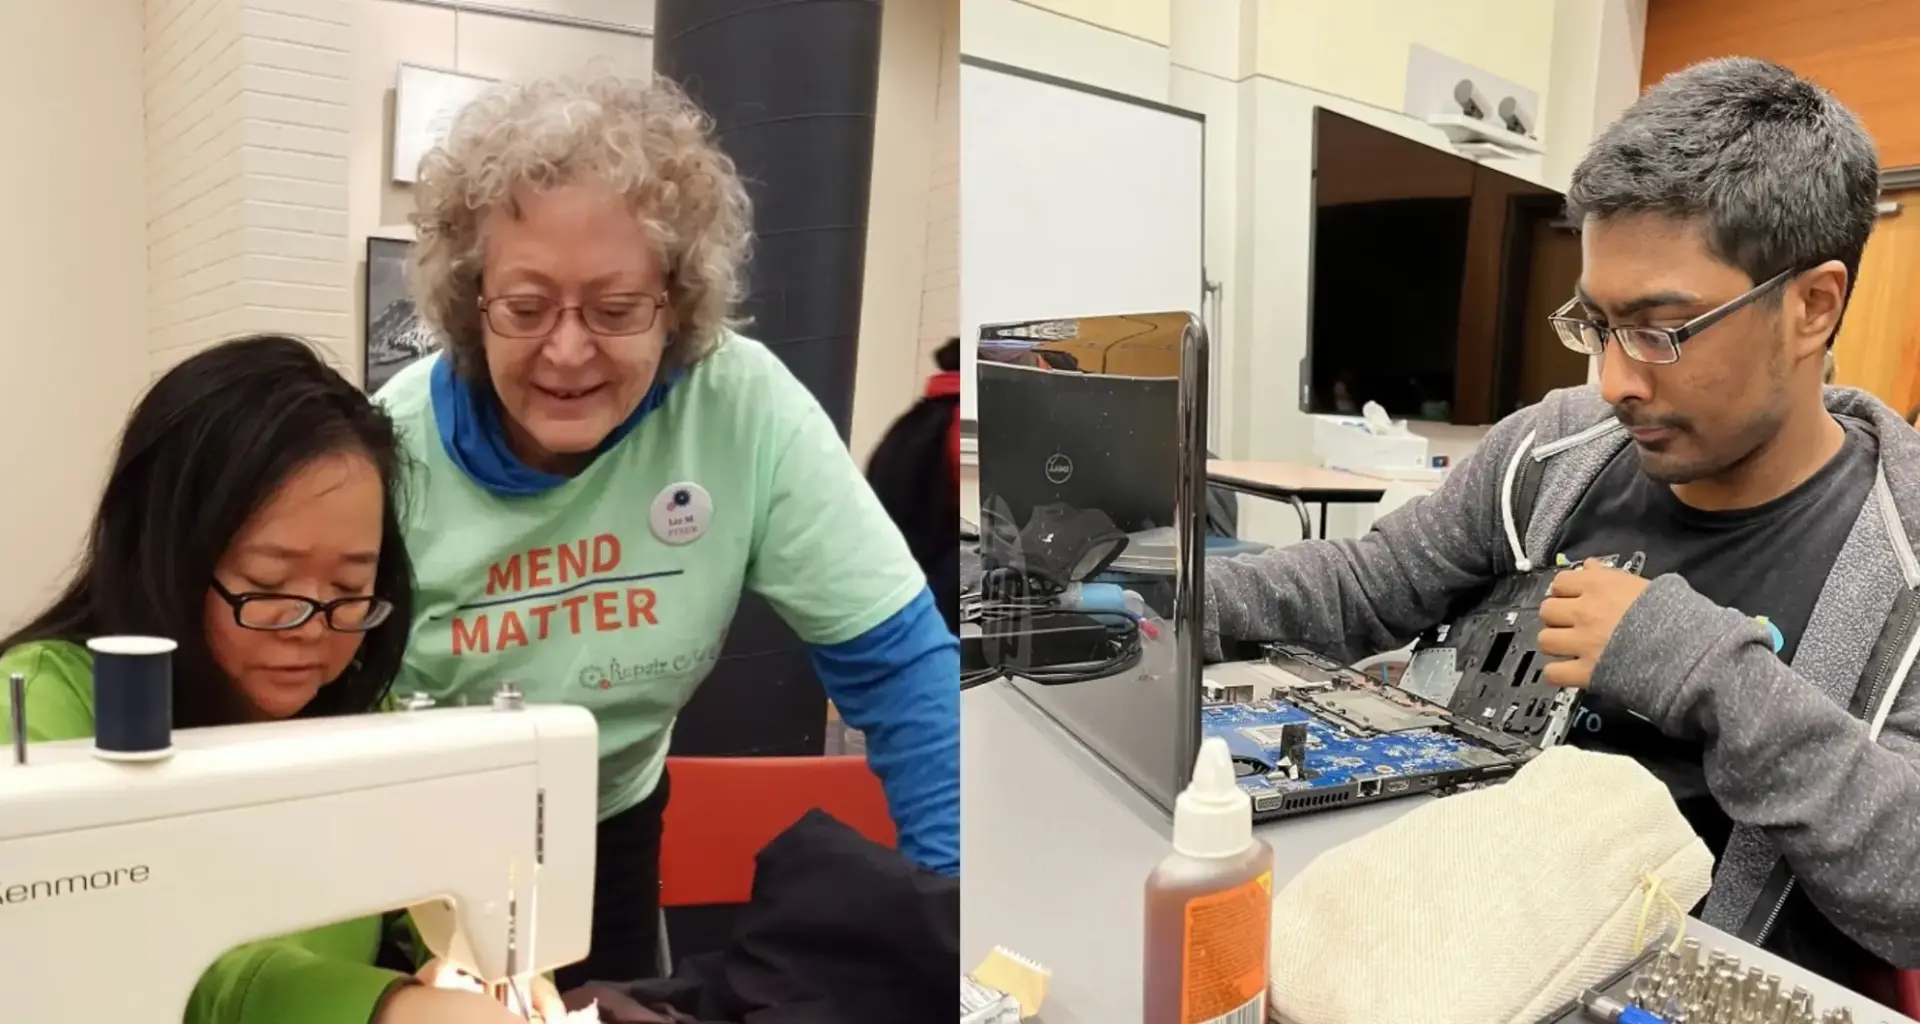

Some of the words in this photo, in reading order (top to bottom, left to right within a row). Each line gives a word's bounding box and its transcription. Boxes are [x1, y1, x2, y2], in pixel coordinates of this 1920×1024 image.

[485, 533, 622, 596] MEND
[451, 588, 660, 656] MATTER
[610, 657, 669, 682] Repair
